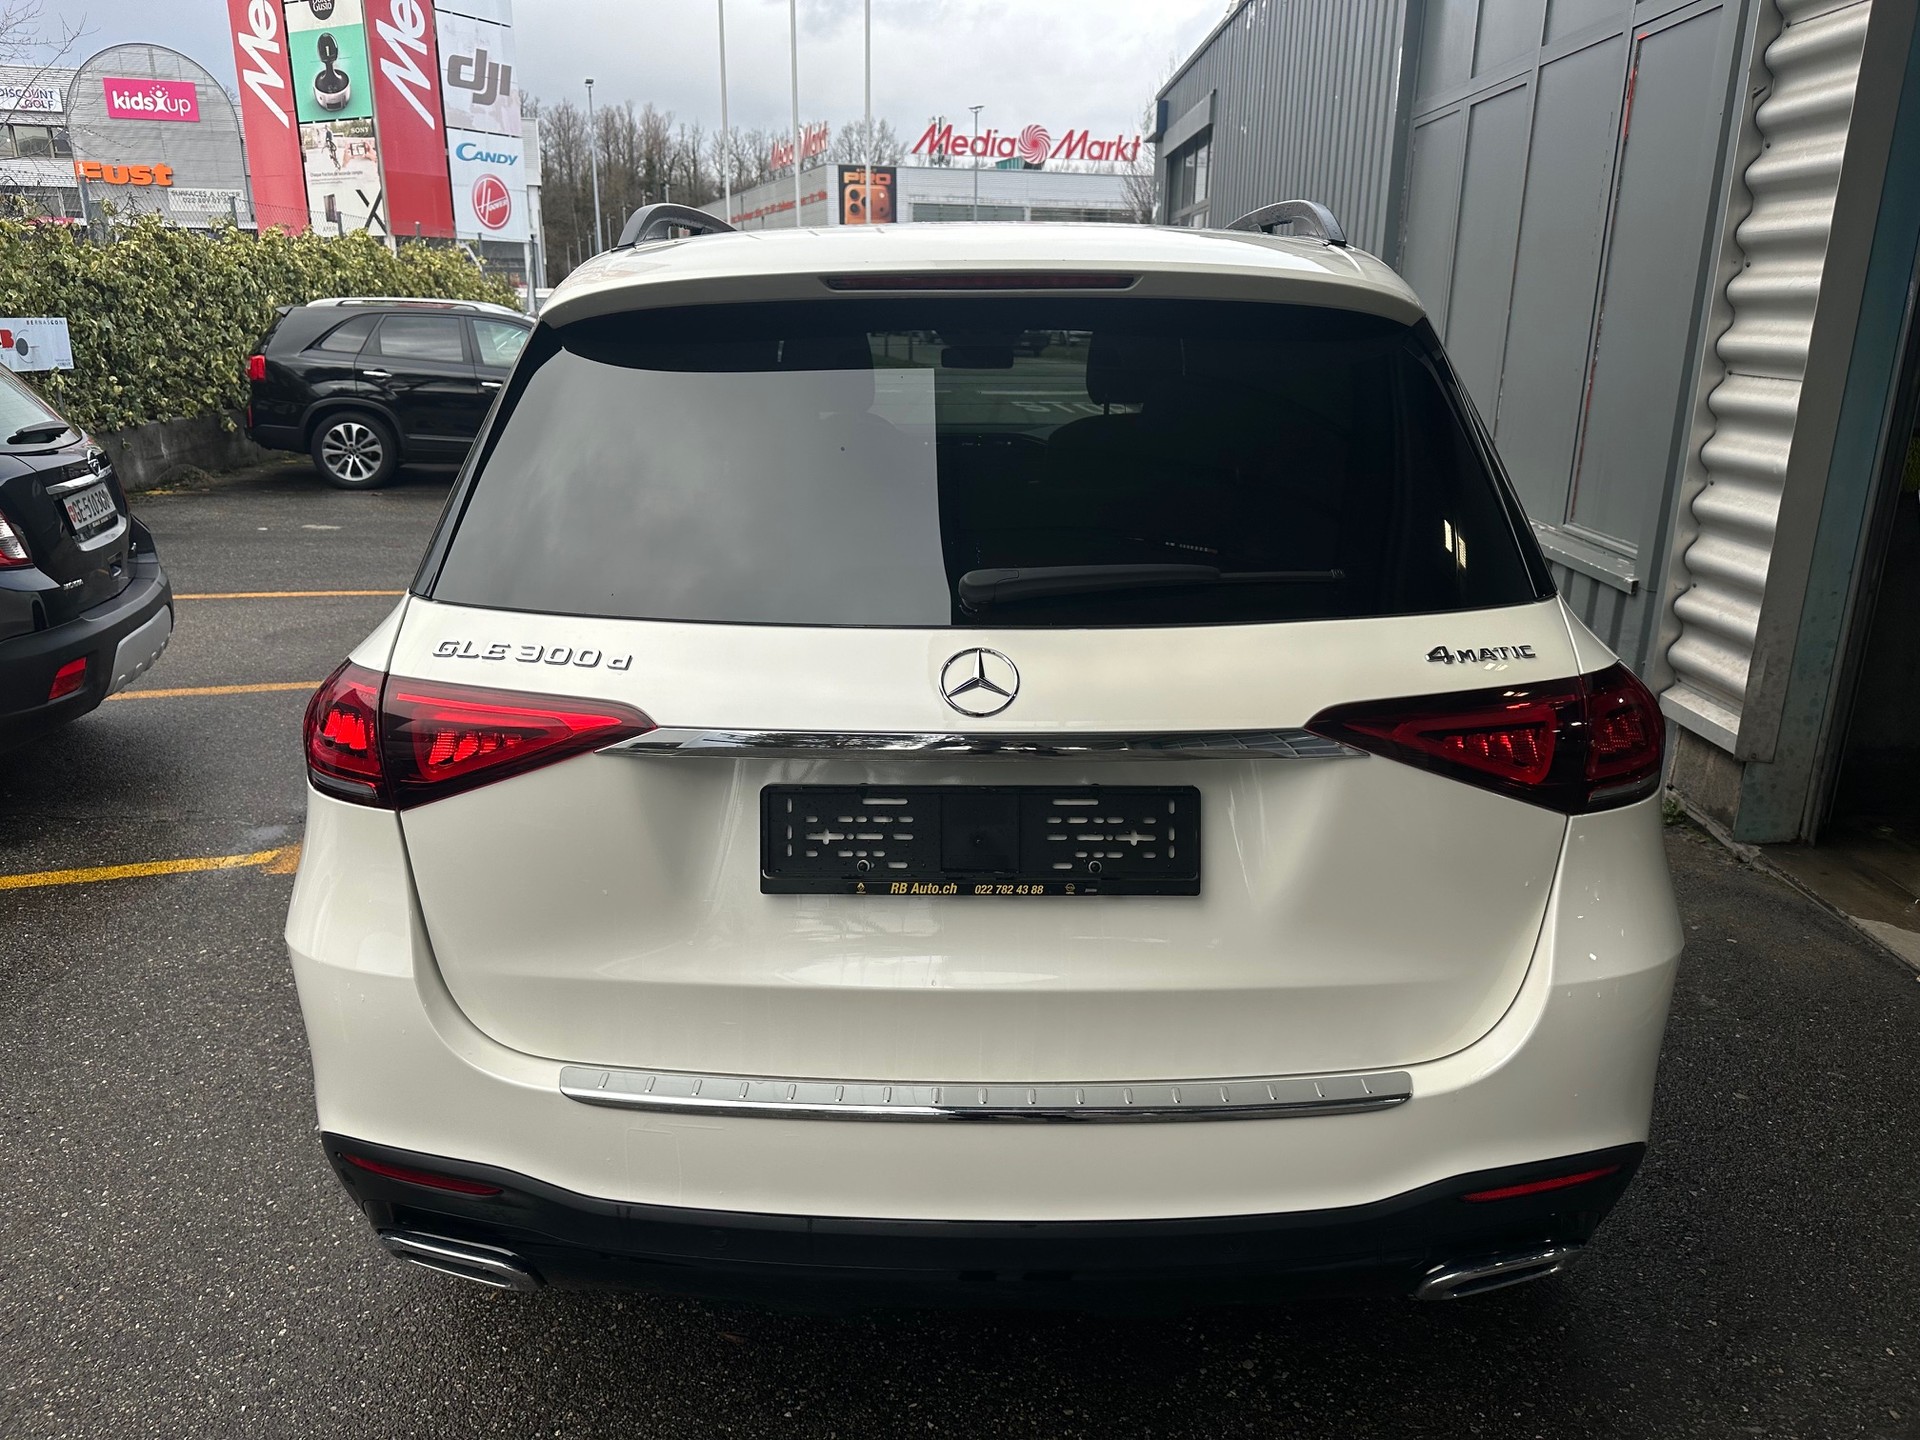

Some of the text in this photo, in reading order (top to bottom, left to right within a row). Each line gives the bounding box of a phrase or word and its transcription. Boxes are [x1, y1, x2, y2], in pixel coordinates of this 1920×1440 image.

[350, 126, 369, 134] SONY
[911, 123, 1142, 162] Media Markt
[843, 171, 891, 185] PRO
[432, 640, 634, 671] GLE 300 d
[1425, 645, 1537, 665] 4MATIC
[890, 882, 1044, 894] RB Auto.ch 022 782 43 88
